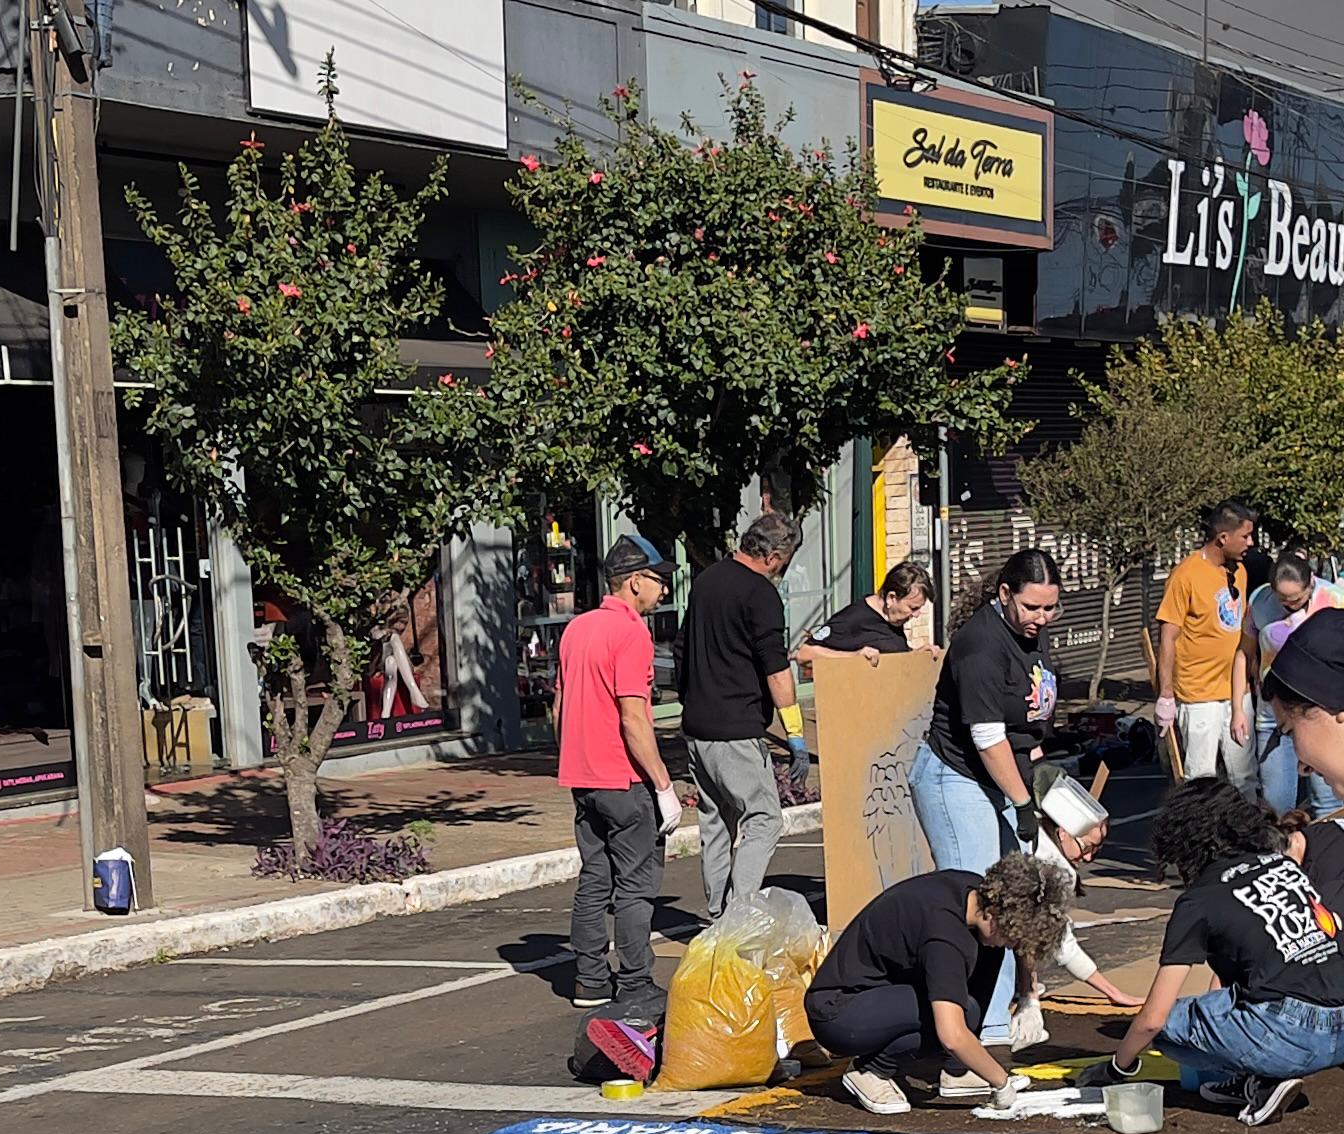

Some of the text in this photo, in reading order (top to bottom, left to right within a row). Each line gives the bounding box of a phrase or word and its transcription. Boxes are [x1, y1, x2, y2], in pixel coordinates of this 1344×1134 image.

[903, 128, 1014, 181] Sal da Terra
[1162, 156, 1235, 270] Li's
[1264, 905, 1318, 949] LUZ
